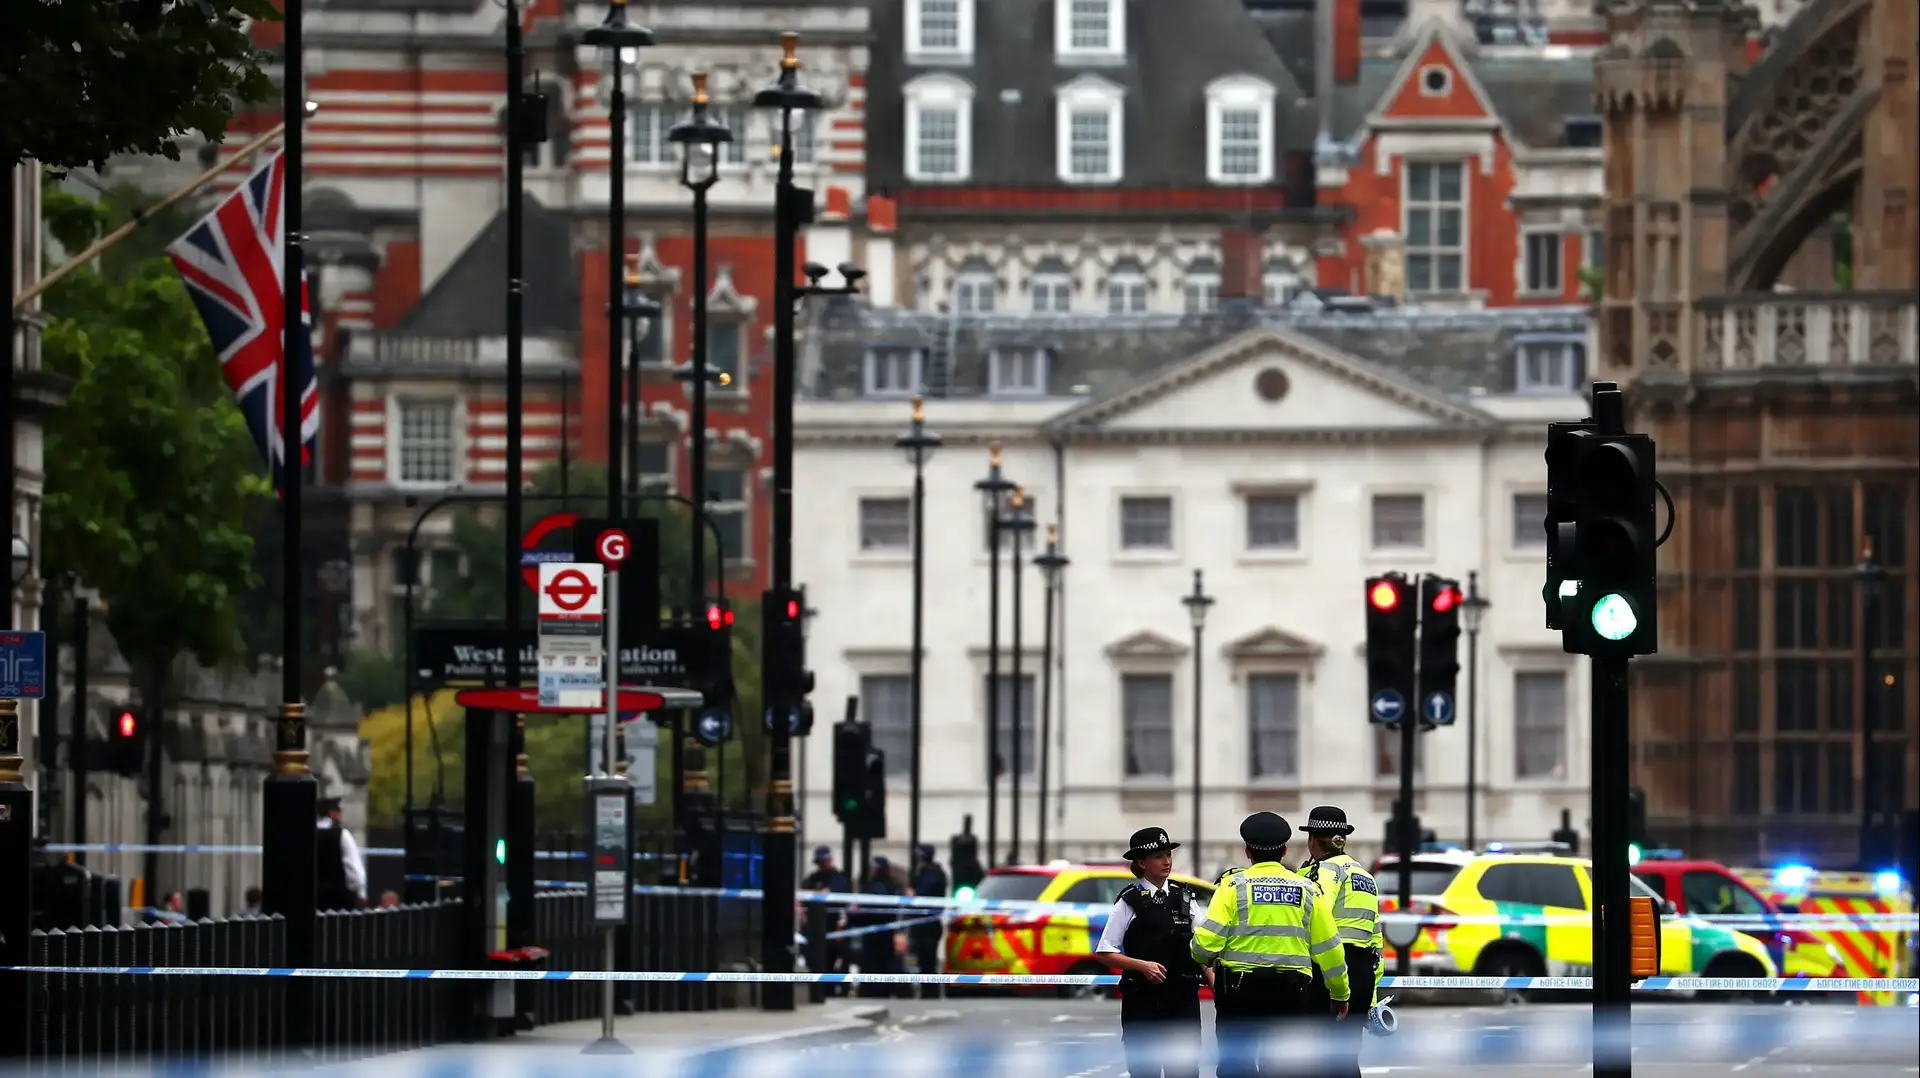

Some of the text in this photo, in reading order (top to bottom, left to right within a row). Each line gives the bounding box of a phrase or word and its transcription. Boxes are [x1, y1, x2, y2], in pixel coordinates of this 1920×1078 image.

[602, 534, 624, 560] G
[619, 645, 677, 662] ation
[1254, 891, 1300, 904] POLICE
